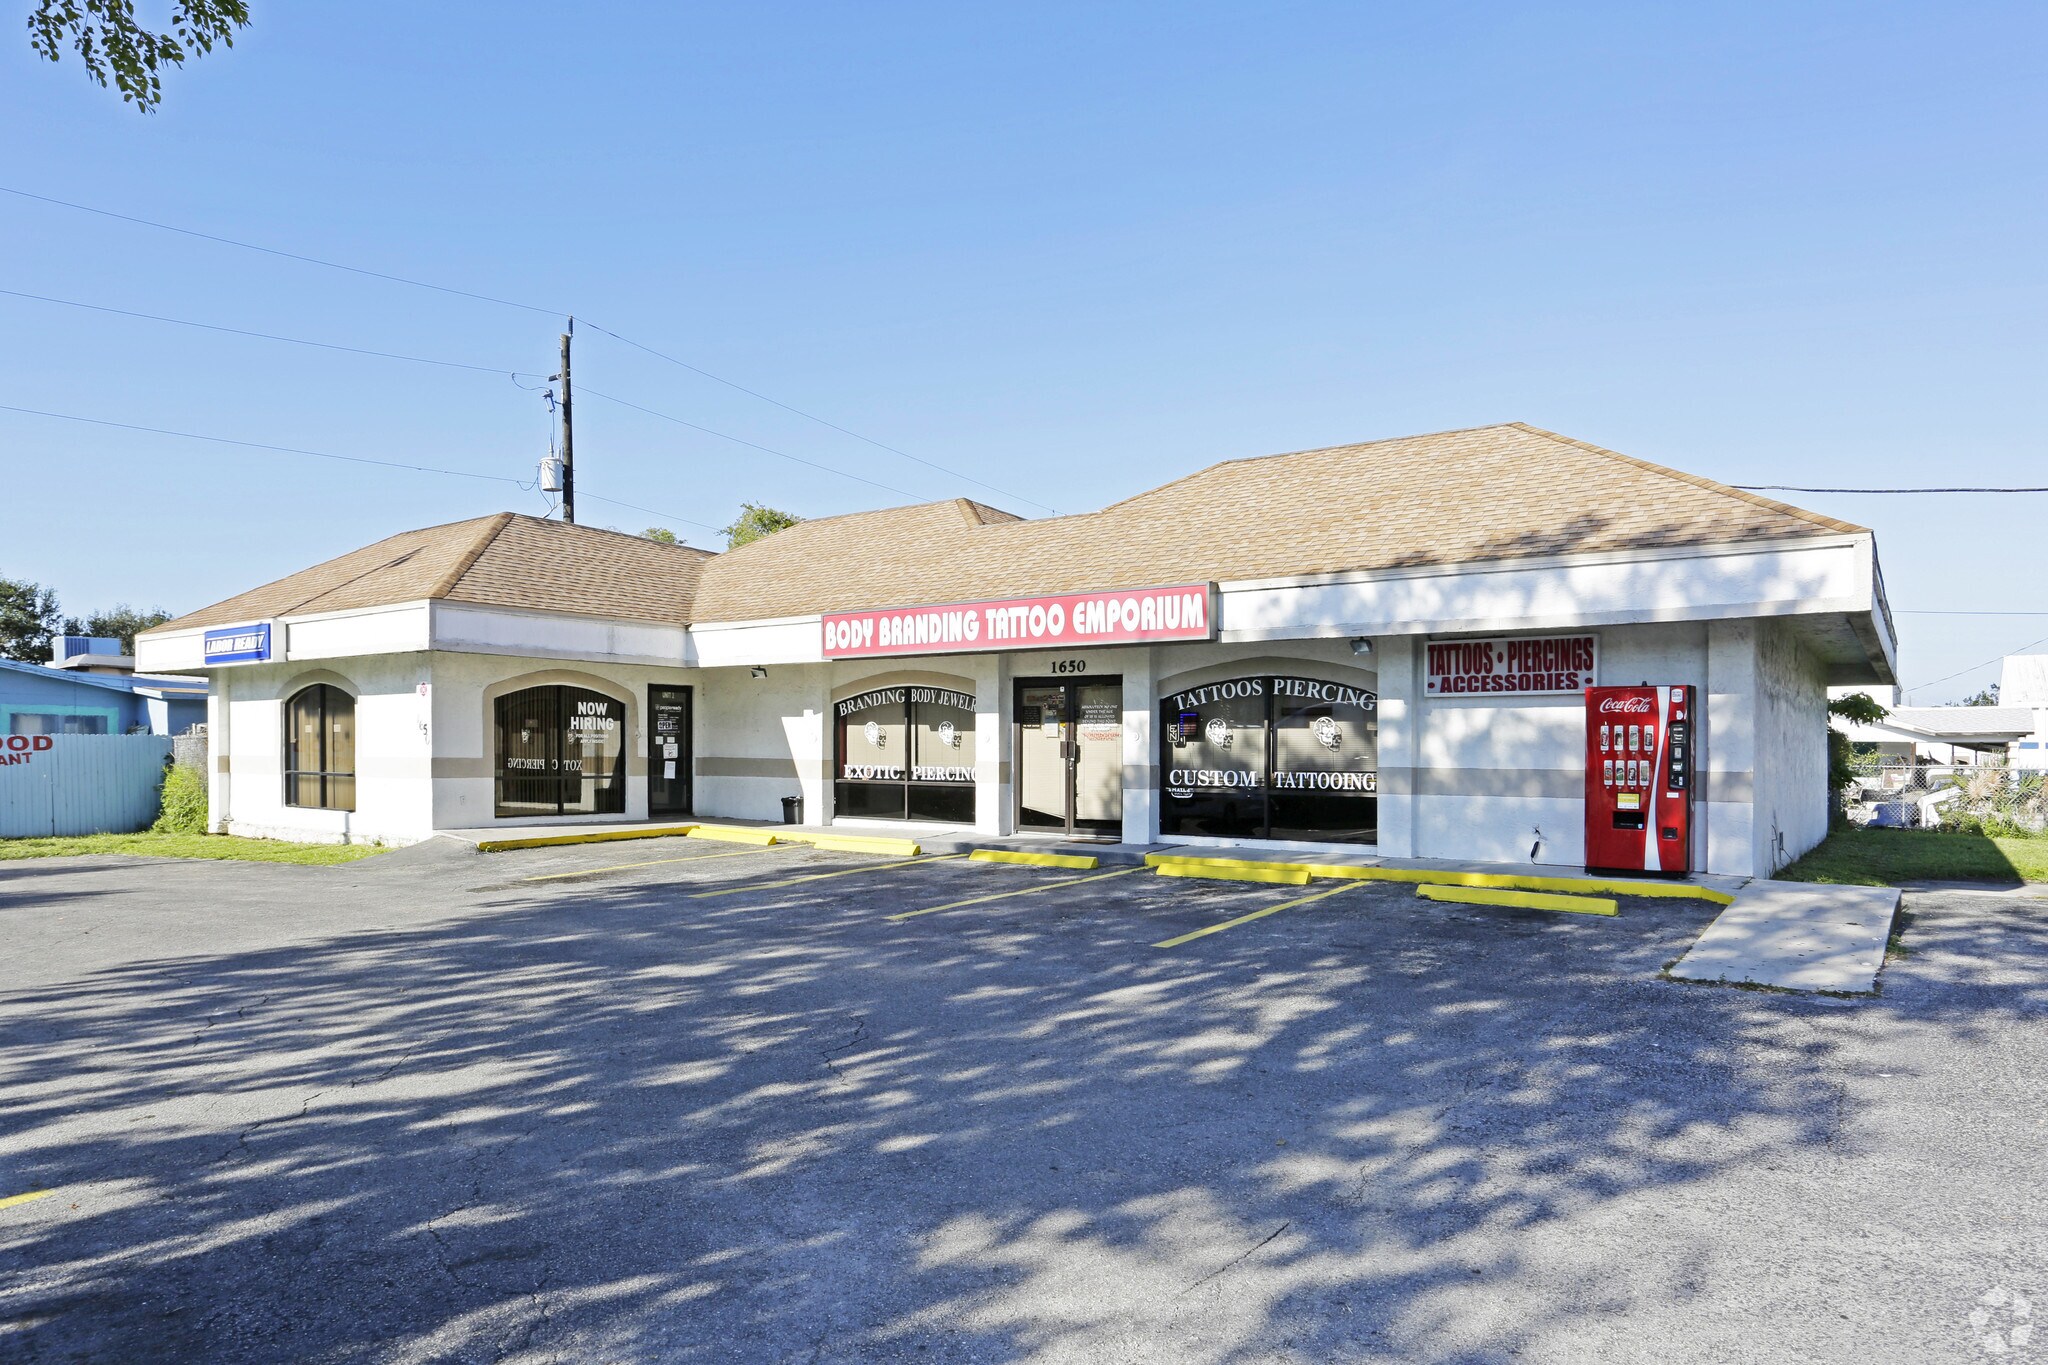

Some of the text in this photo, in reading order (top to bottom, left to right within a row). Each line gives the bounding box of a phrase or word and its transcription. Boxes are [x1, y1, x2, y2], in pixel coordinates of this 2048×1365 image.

[825, 593, 1204, 650] BODY BRANDING TATTOO EMPORIUM
[205, 634, 265, 654] LABOR READY
[1427, 637, 1594, 676] TATTOOS PIERCINGS
[1050, 660, 1086, 674] 1650
[1439, 672, 1579, 693] ACCESSORIES
[838, 689, 905, 717] BRANDING
[911, 688, 938, 704] BODY
[1173, 678, 1376, 711] TATTOOS PIERCING
[577, 701, 608, 716] NOW
[1599, 697, 1653, 714] Coca-Cola
[570, 716, 614, 731] HIRING
[0, 735, 53, 751] OD
[843, 764, 900, 780] EXOTIC
[1169, 769, 1377, 791] CUSTOM TATTOOING
